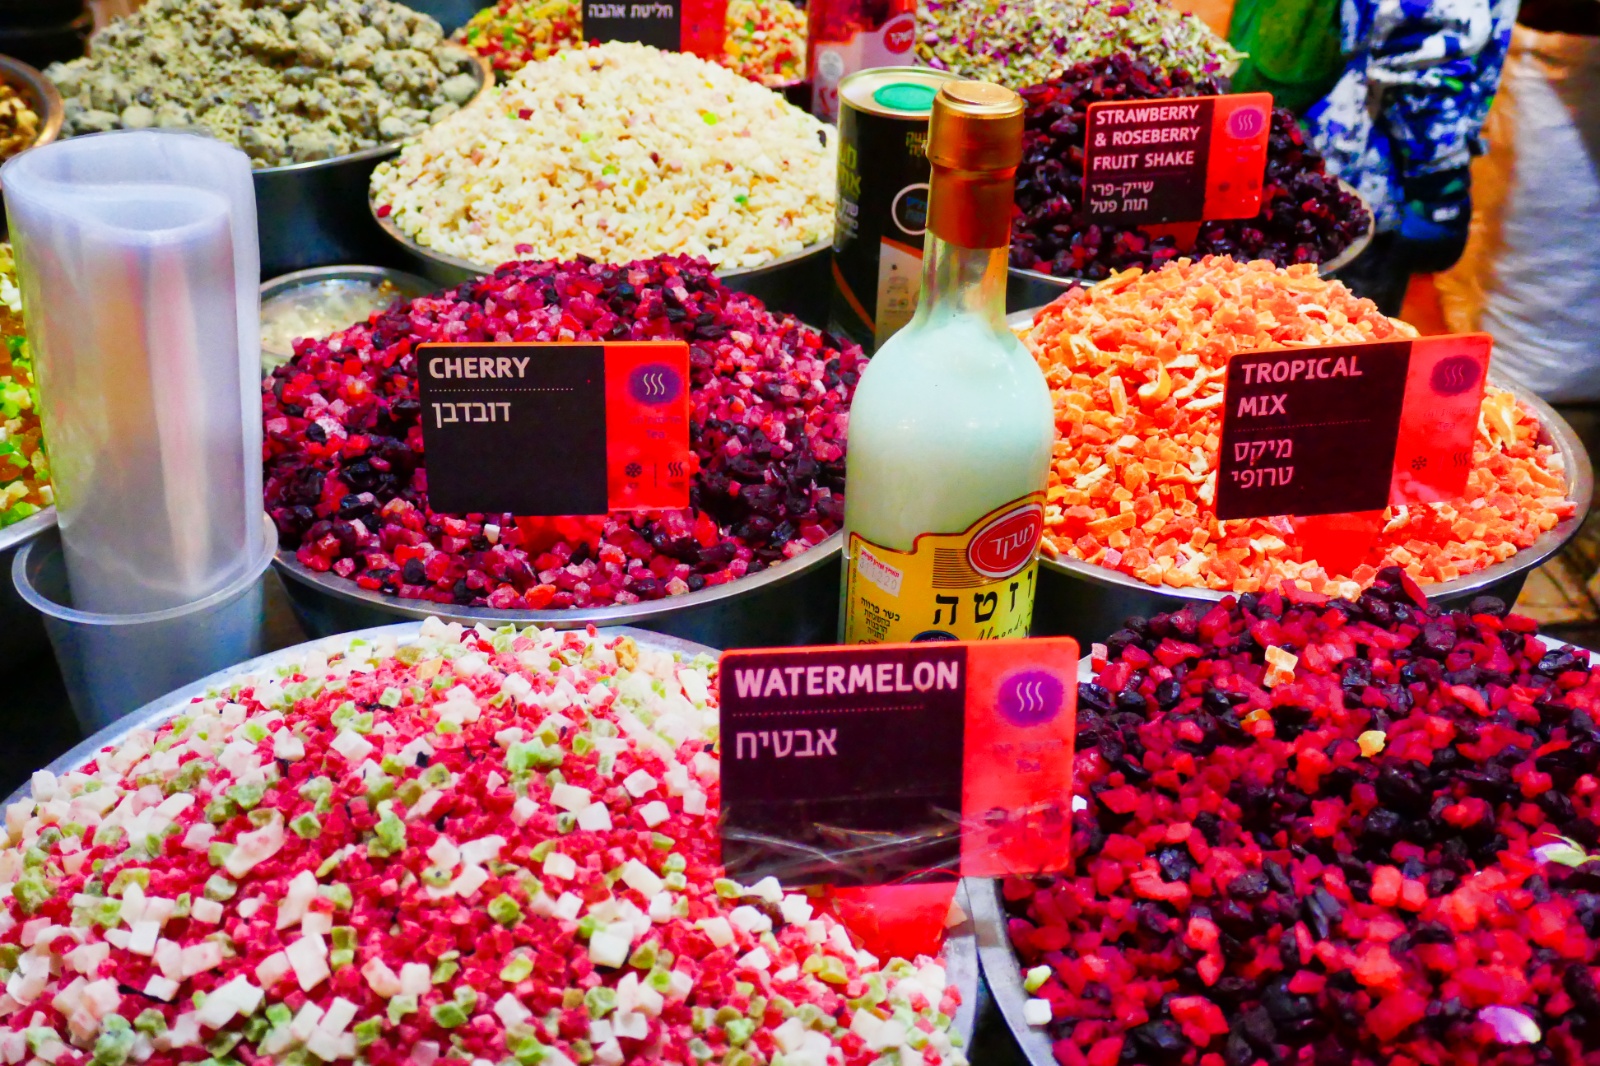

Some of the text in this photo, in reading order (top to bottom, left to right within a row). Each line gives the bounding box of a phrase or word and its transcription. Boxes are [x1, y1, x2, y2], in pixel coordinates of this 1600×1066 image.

[588, 1, 674, 19] חליטת אהבה
[1095, 104, 1200, 126] STRAWBERRY
[1094, 126, 1201, 147] & ROSEBERRY
[1093, 150, 1195, 171] FRUIT SHAKE
[1091, 179, 1155, 197] שייק-פרי
[1090, 197, 1149, 214] תות פטל
[428, 356, 531, 380] CHERRY
[1241, 355, 1363, 385] TROPICAL
[431, 401, 512, 429] דובדבן
[1237, 394, 1289, 418] MIX
[1234, 438, 1293, 467] מיקס
[1231, 465, 1294, 489] טרופי
[861, 597, 901, 622] כשר פרווה
[734, 660, 959, 698] WATERMELON
[735, 728, 838, 760] אבטיח
